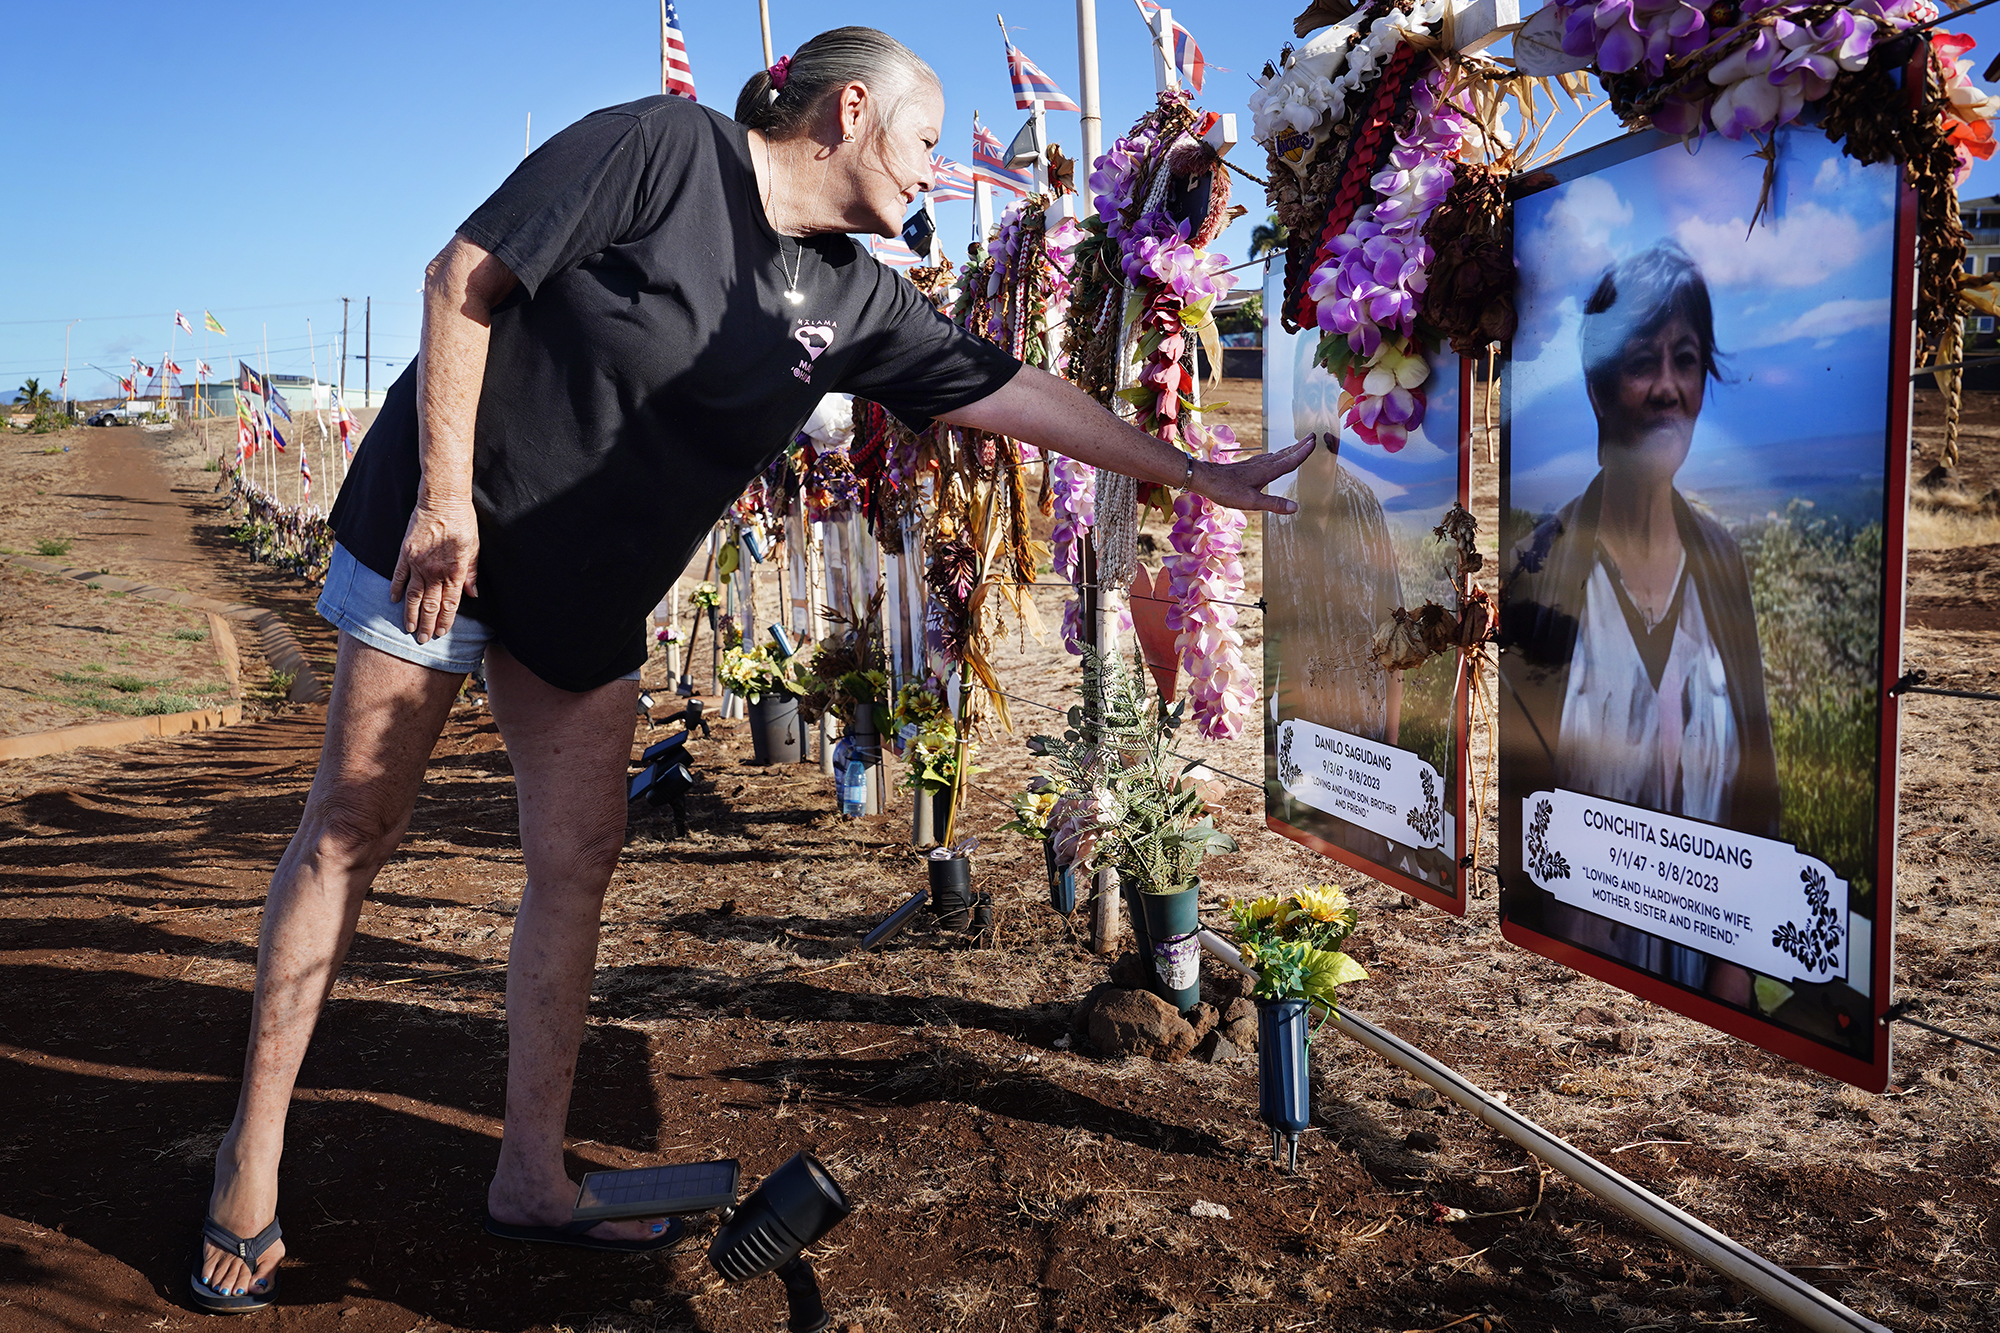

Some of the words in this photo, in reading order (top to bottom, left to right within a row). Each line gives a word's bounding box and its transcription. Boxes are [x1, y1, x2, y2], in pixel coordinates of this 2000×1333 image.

[1276, 131, 1315, 157] LAKERS
[1315, 734, 1343, 755] DANILO
[1344, 743, 1391, 771] SAGUDANG
[1322, 760, 1343, 777] 9/3/67
[1348, 768, 1380, 791] 8/8/2023
[1331, 784, 1342, 795] AND
[1343, 787, 1357, 800] KIND
[1370, 797, 1397, 815] BROTHER
[1335, 798, 1346, 810] AND
[1583, 808, 1657, 845] CONCHITA
[1660, 827, 1753, 870] SAGUDANG
[1609, 847, 1647, 871] 9/1/47
[1658, 861, 1719, 893] 8/8/2023
[1592, 887, 1632, 912] MOTHER,
[1634, 900, 1667, 923] SISTER
[1669, 913, 1691, 930] AND
[1620, 879, 1641, 895] AND
[1643, 884, 1721, 920] HARDWORKING
[1723, 909, 1753, 933] WIFE,
